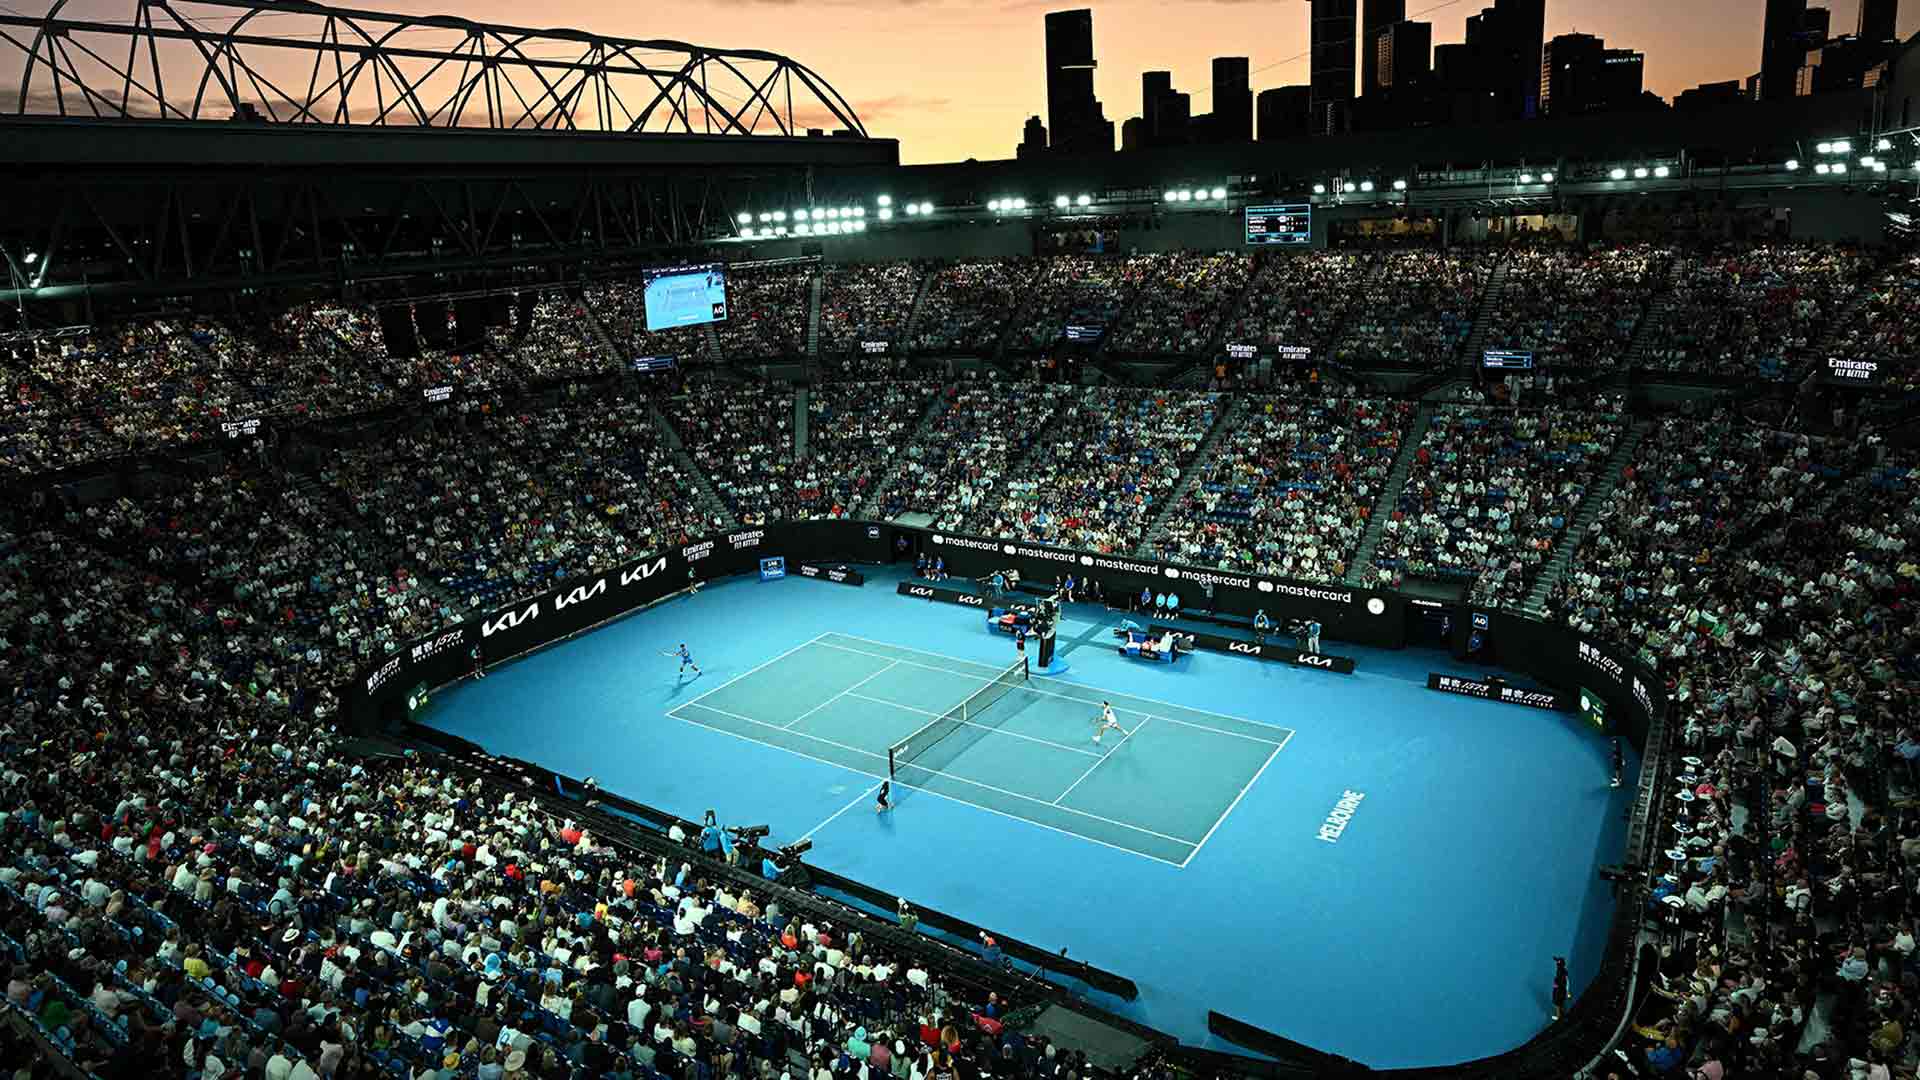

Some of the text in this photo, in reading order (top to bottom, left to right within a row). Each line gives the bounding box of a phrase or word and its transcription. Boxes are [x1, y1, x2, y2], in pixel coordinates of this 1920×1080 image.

[714, 306, 724, 314] AO
[1226, 344, 1257, 352] Emirates
[1279, 345, 1311, 354] Emirates
[1828, 358, 1878, 371] Emirates
[728, 530, 765, 544] Emirates
[945, 536, 999, 552] mastercard
[682, 541, 715, 557] Emirates
[1018, 547, 1076, 563] mastercard
[1096, 558, 1159, 575] mastercard
[1181, 570, 1250, 588] mastercard
[1276, 583, 1352, 603] mastercard
[1474, 617, 1486, 625] AO
[1314, 789, 1366, 843] MELBOURNE
